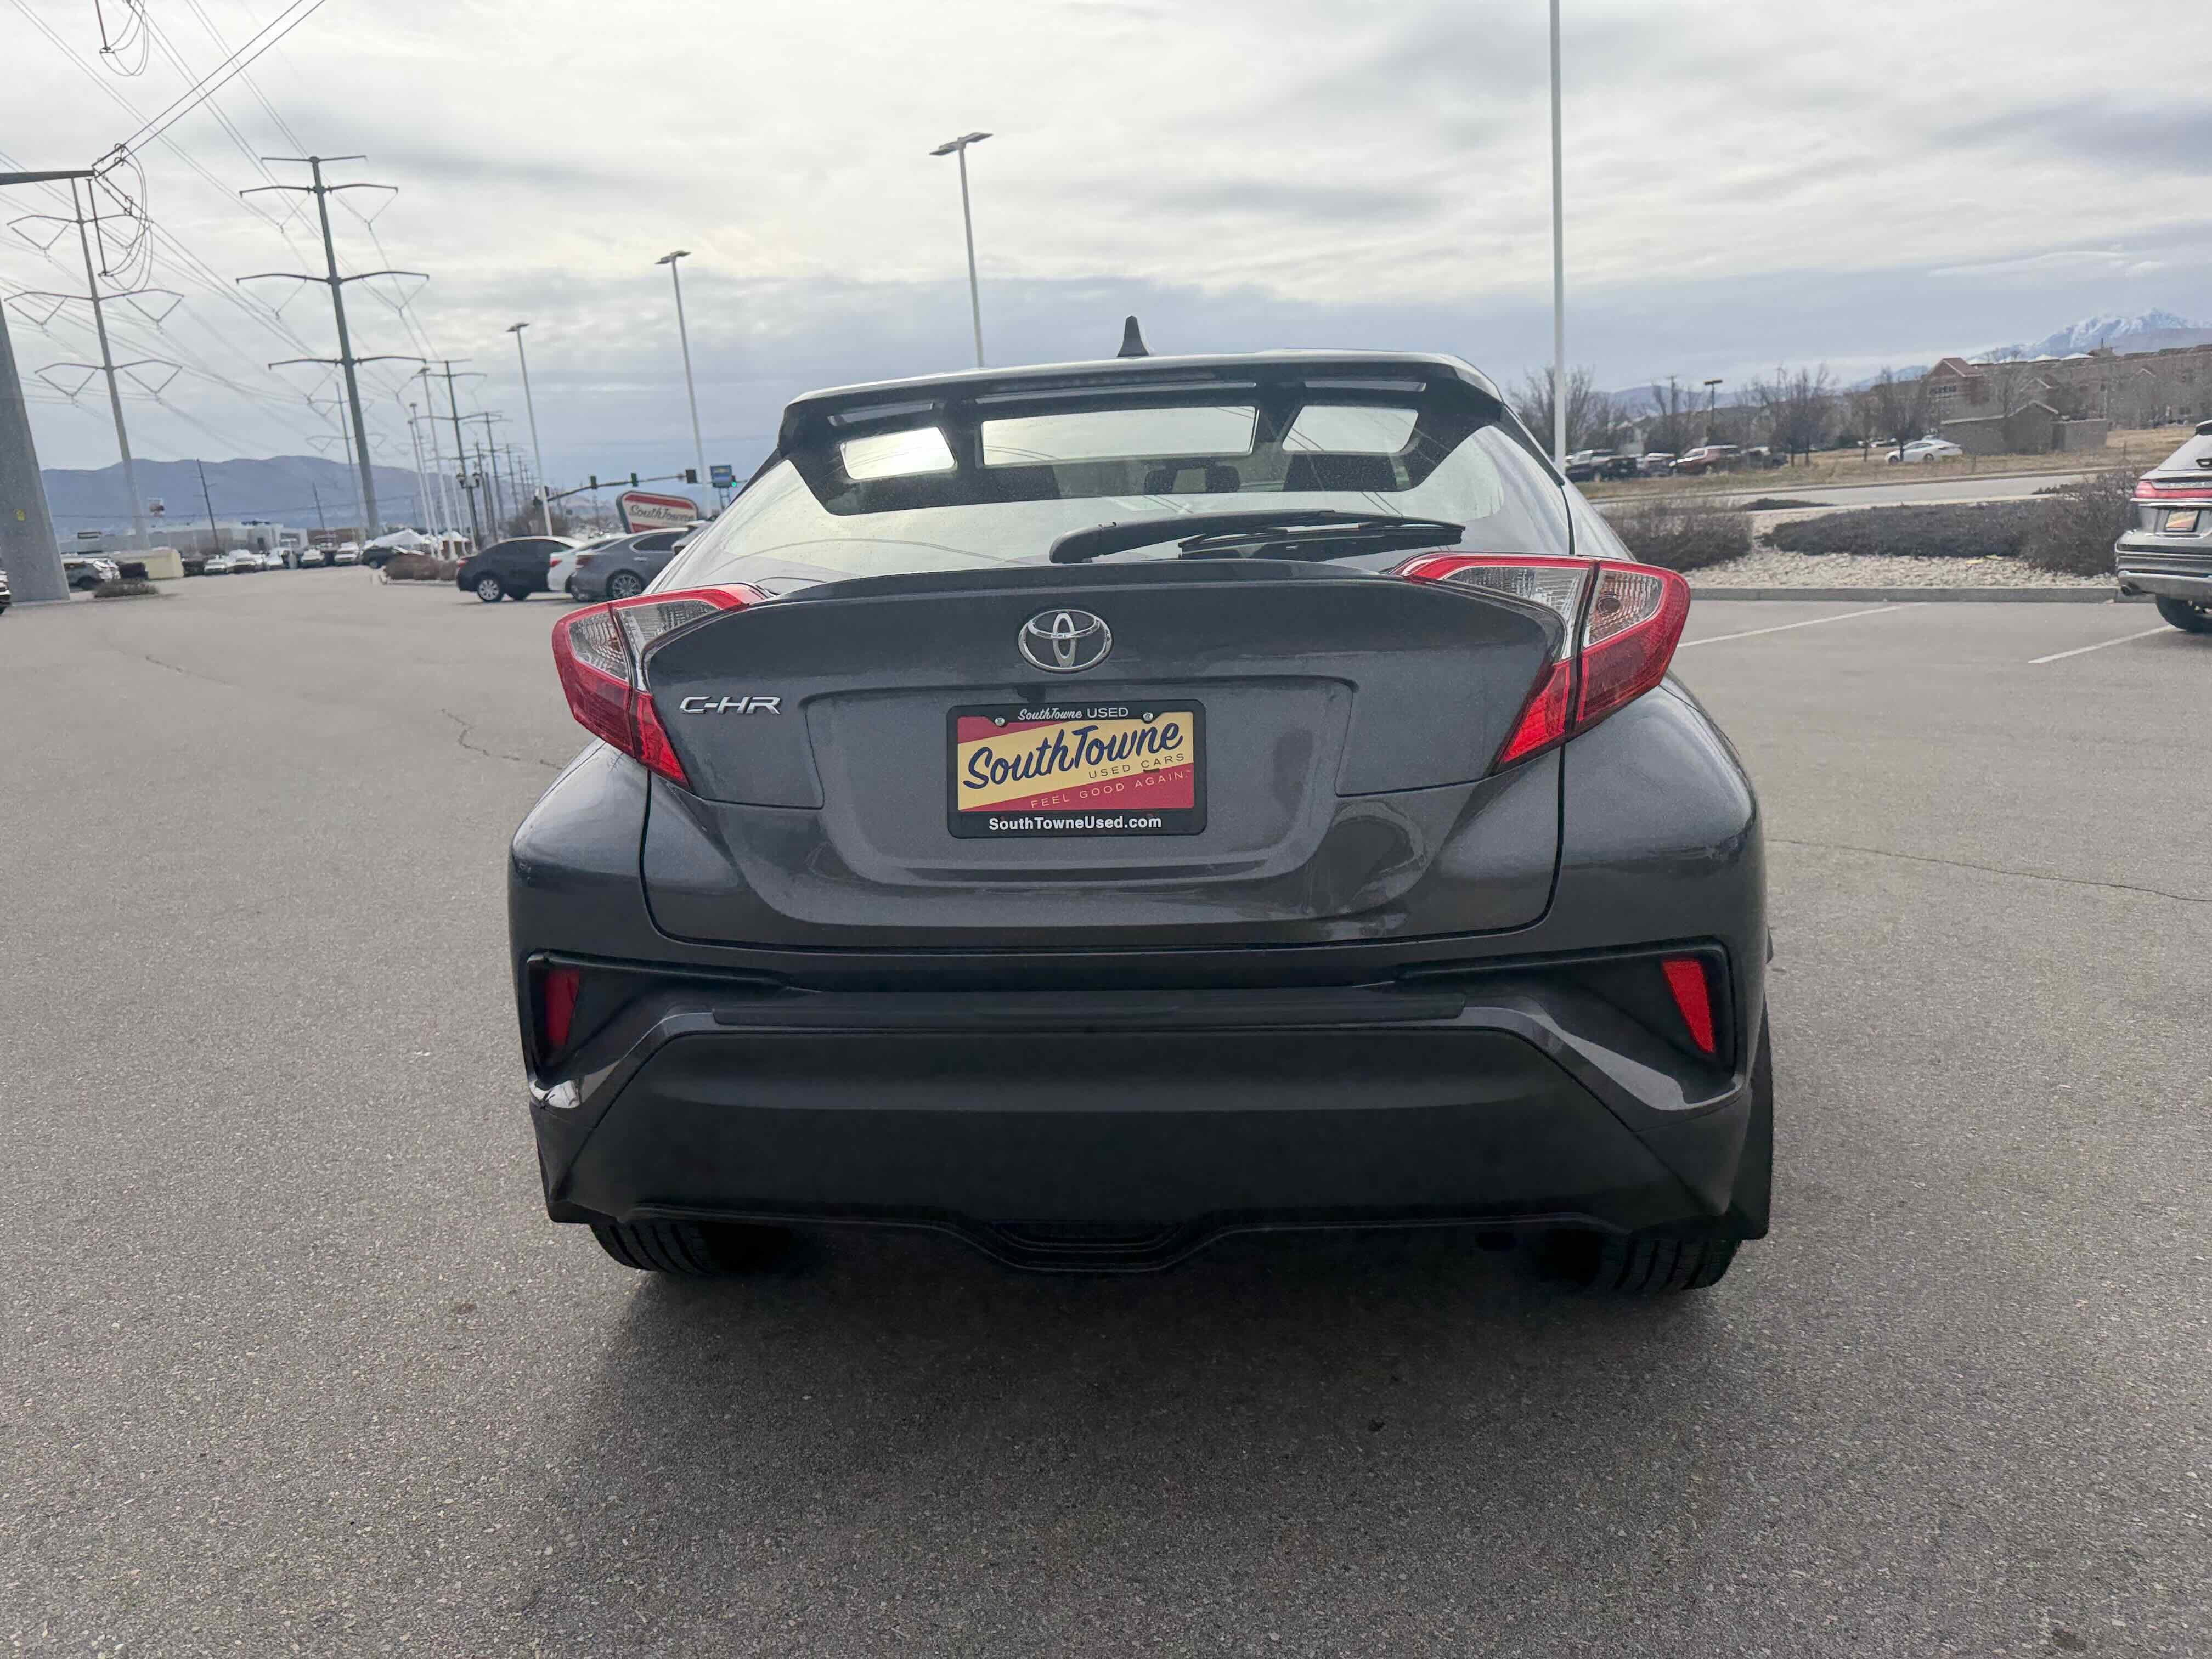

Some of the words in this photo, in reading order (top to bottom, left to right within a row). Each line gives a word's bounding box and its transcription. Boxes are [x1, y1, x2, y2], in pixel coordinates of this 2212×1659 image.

[680, 696, 781, 715] C-HR
[1018, 708, 1083, 721] SouthTowne
[1087, 707, 1128, 718] USED
[963, 722, 1183, 789] SouthTowne
[1088, 764, 1131, 779] USED
[1141, 753, 1185, 769] CARS
[1031, 794, 1070, 808] FEEL
[1079, 783, 1125, 799] GOOD
[988, 815, 1162, 831] SouthTowneUsed.com
